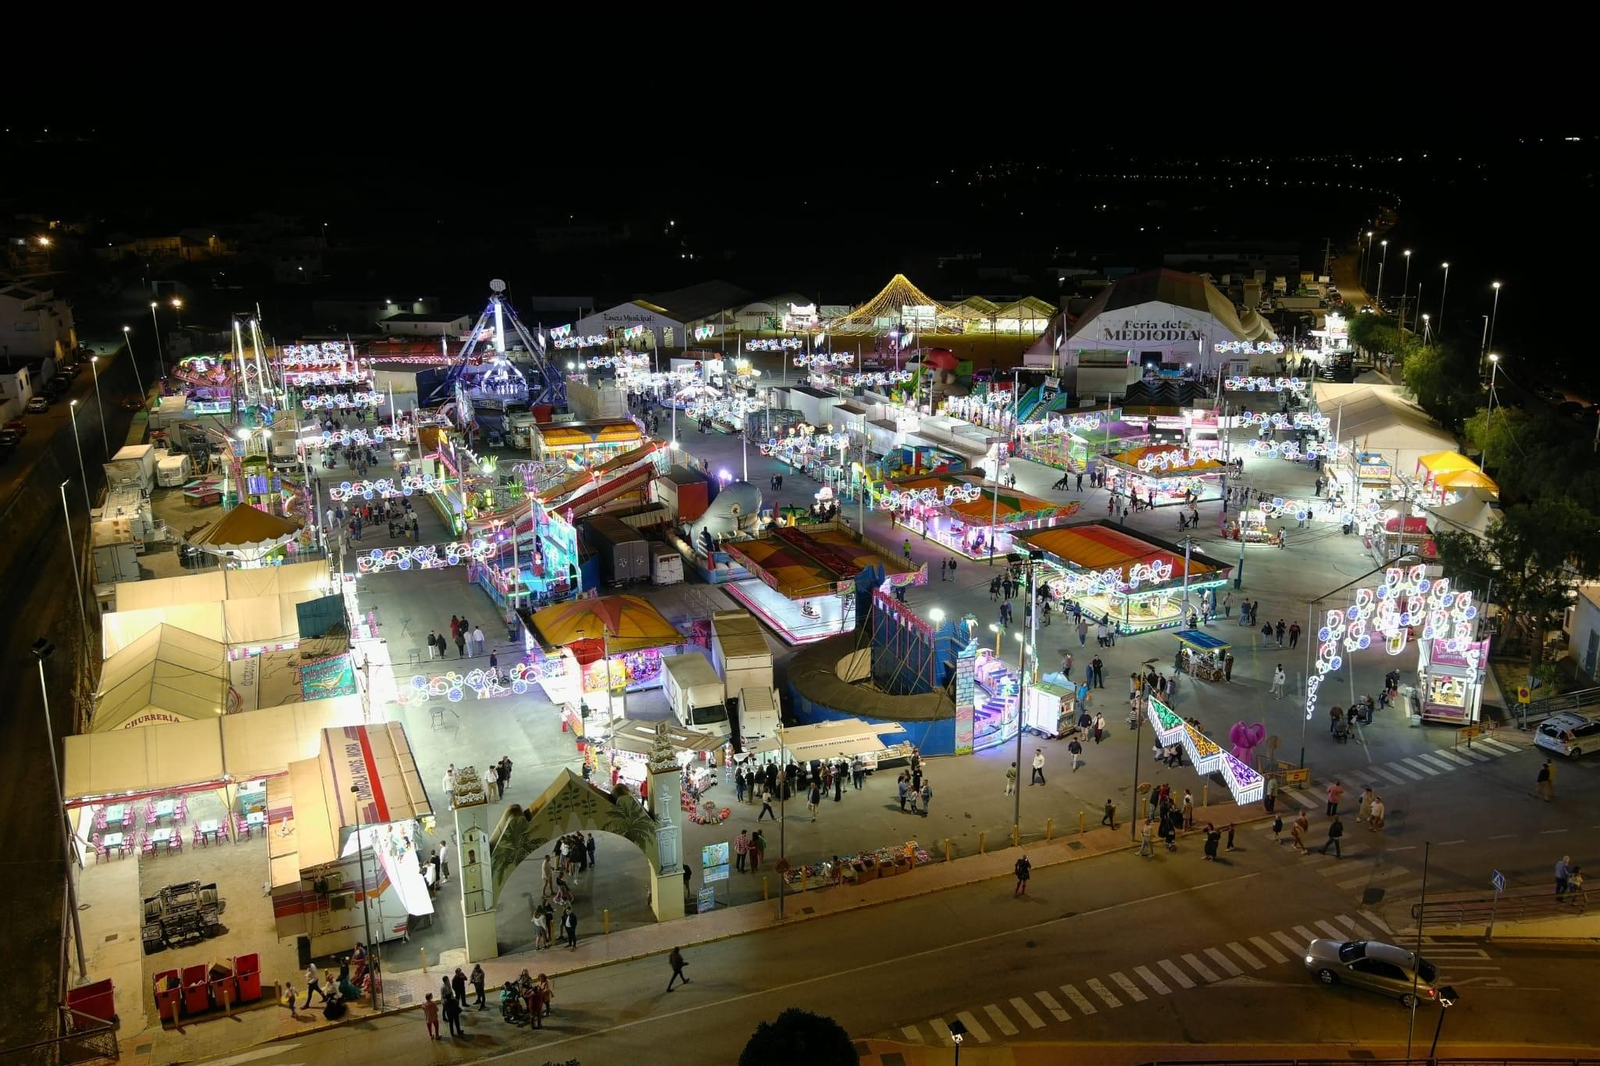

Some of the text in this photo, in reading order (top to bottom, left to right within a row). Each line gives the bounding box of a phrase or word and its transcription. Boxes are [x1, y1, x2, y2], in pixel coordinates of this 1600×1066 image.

[624, 314, 652, 323] Municipal
[1124, 320, 1182, 330] Feria del
[124, 713, 180, 730] CHURRERÍA
[345, 742, 362, 758] MORA
